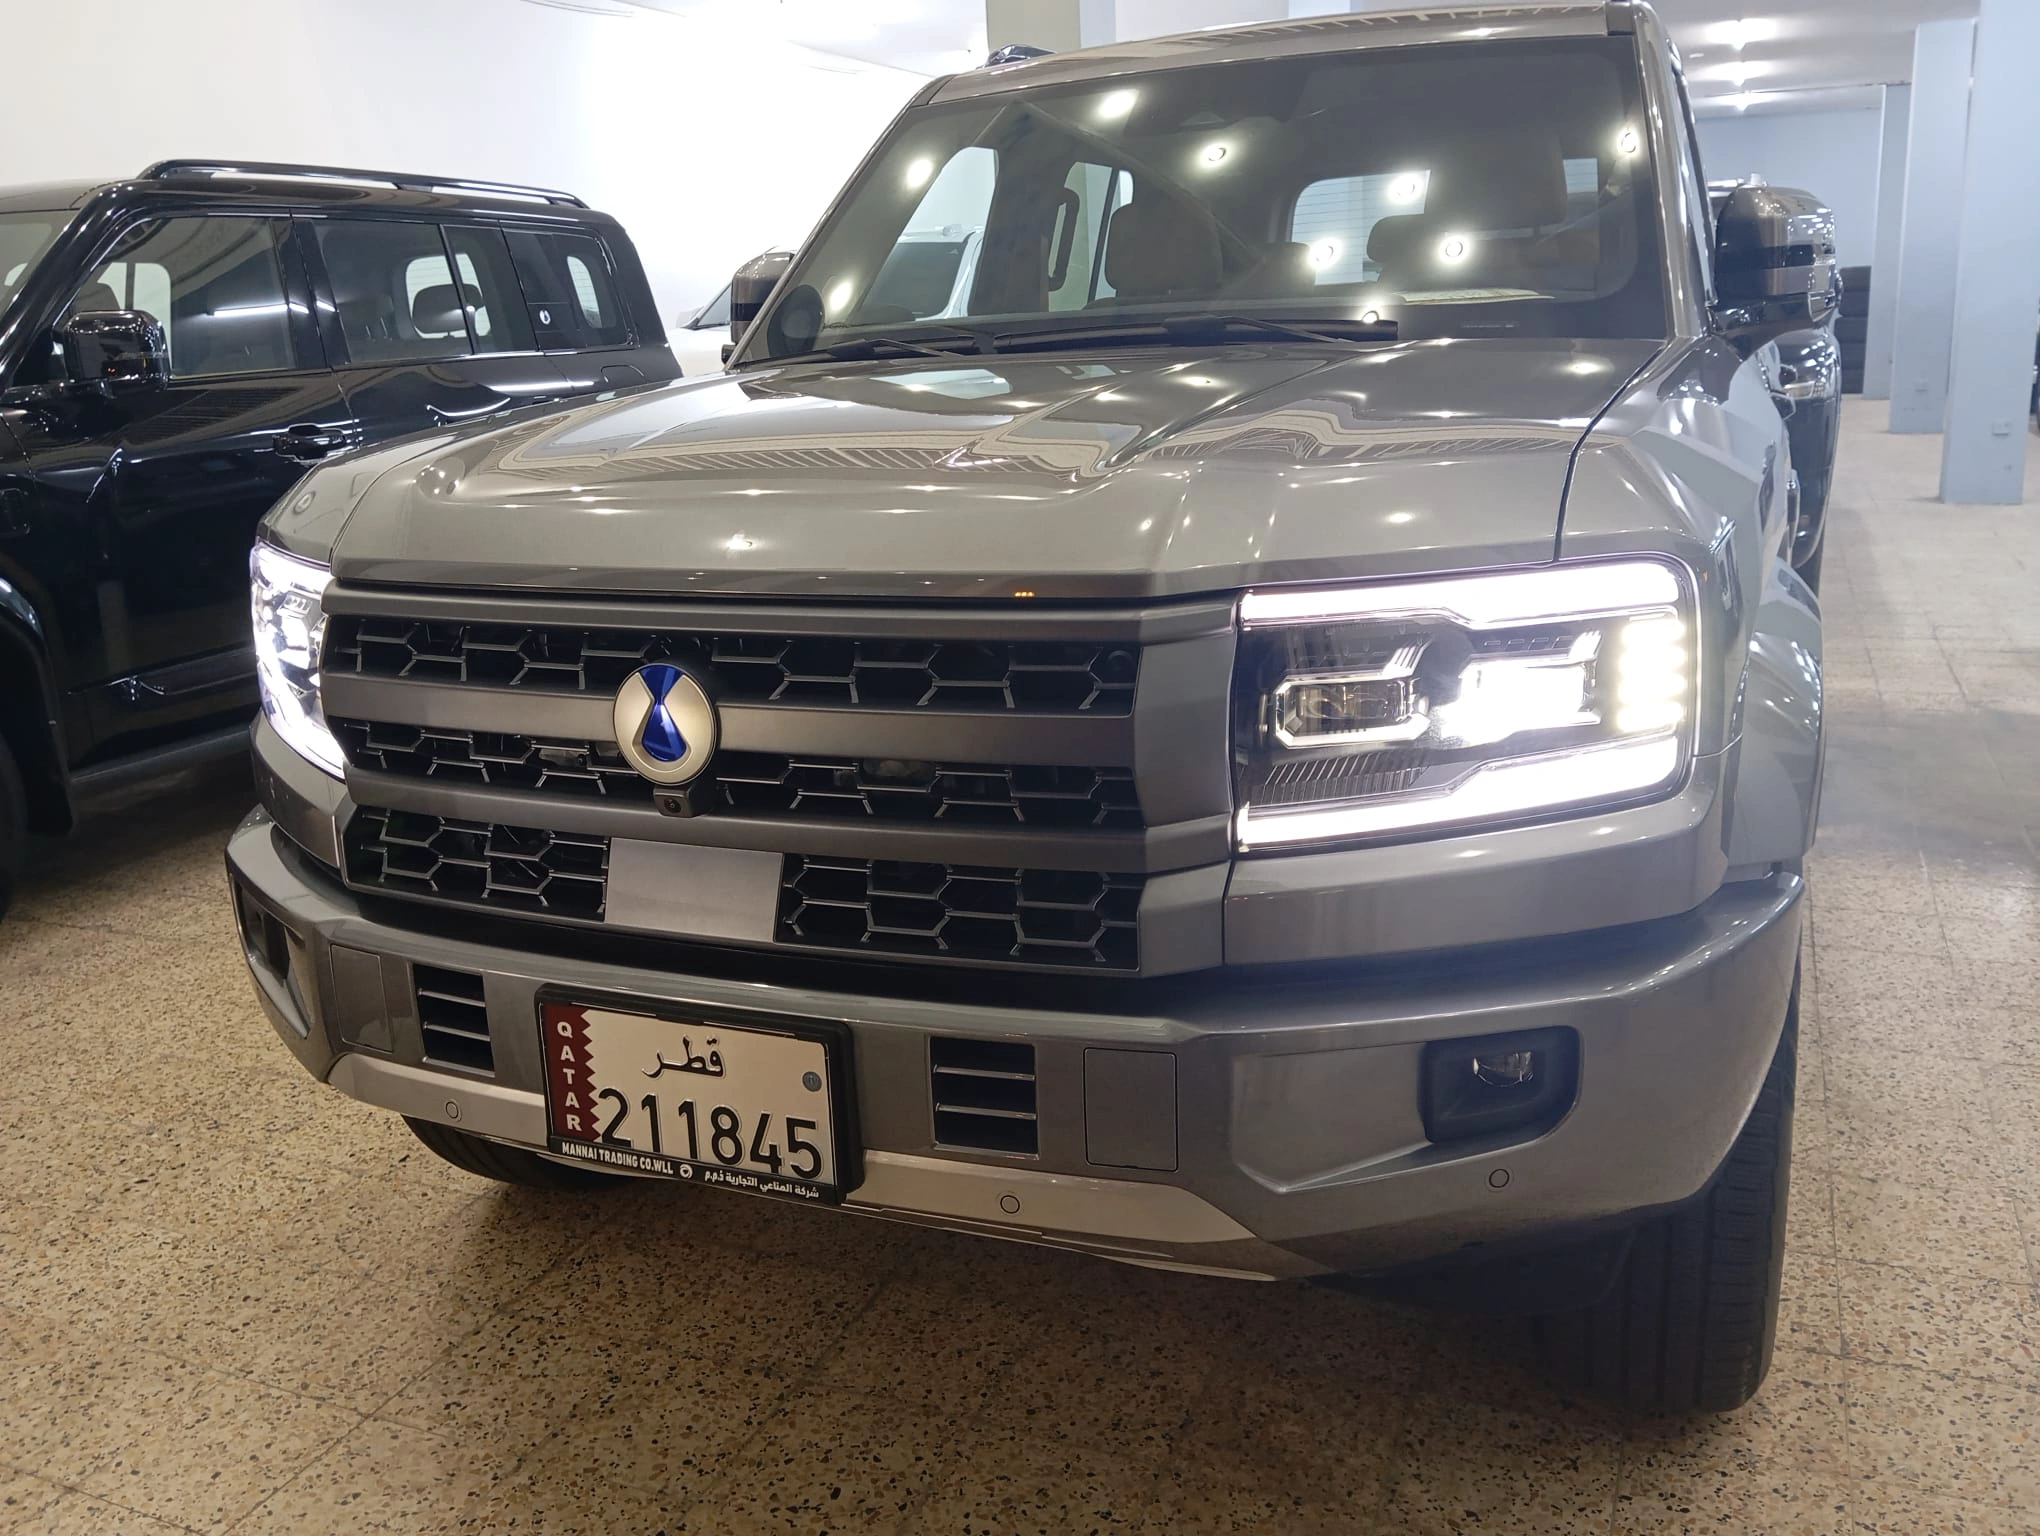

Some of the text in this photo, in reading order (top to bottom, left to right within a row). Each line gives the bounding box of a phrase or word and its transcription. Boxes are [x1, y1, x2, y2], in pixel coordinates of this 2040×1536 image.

[641, 1035, 724, 1079] قطر
[557, 1021, 582, 1131] QATAR
[598, 1087, 823, 1180] 211845
[562, 1142, 597, 1160] MANNAI
[599, 1149, 638, 1168] TRADING
[726, 1173, 758, 1187] التجارية
[760, 1183, 793, 1193] المناعي
[795, 1185, 819, 1198] شركة
